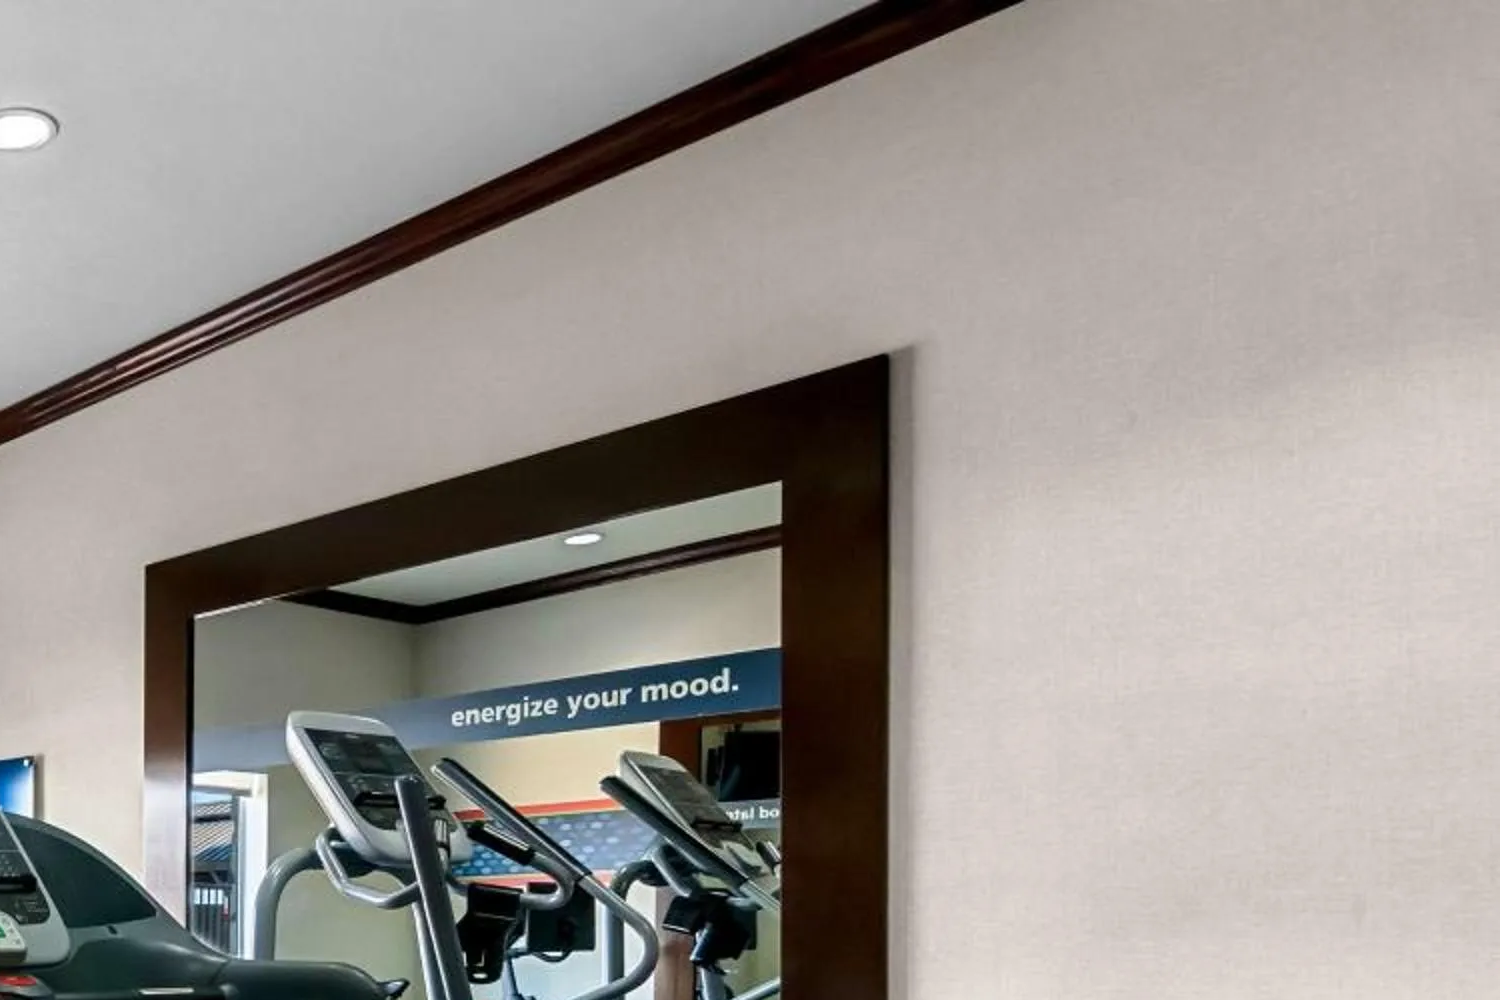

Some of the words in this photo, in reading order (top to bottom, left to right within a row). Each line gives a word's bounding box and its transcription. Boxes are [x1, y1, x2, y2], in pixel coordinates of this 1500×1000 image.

[451, 696, 559, 727] energize
[567, 686, 633, 719] your
[641, 667, 740, 703] mood.
